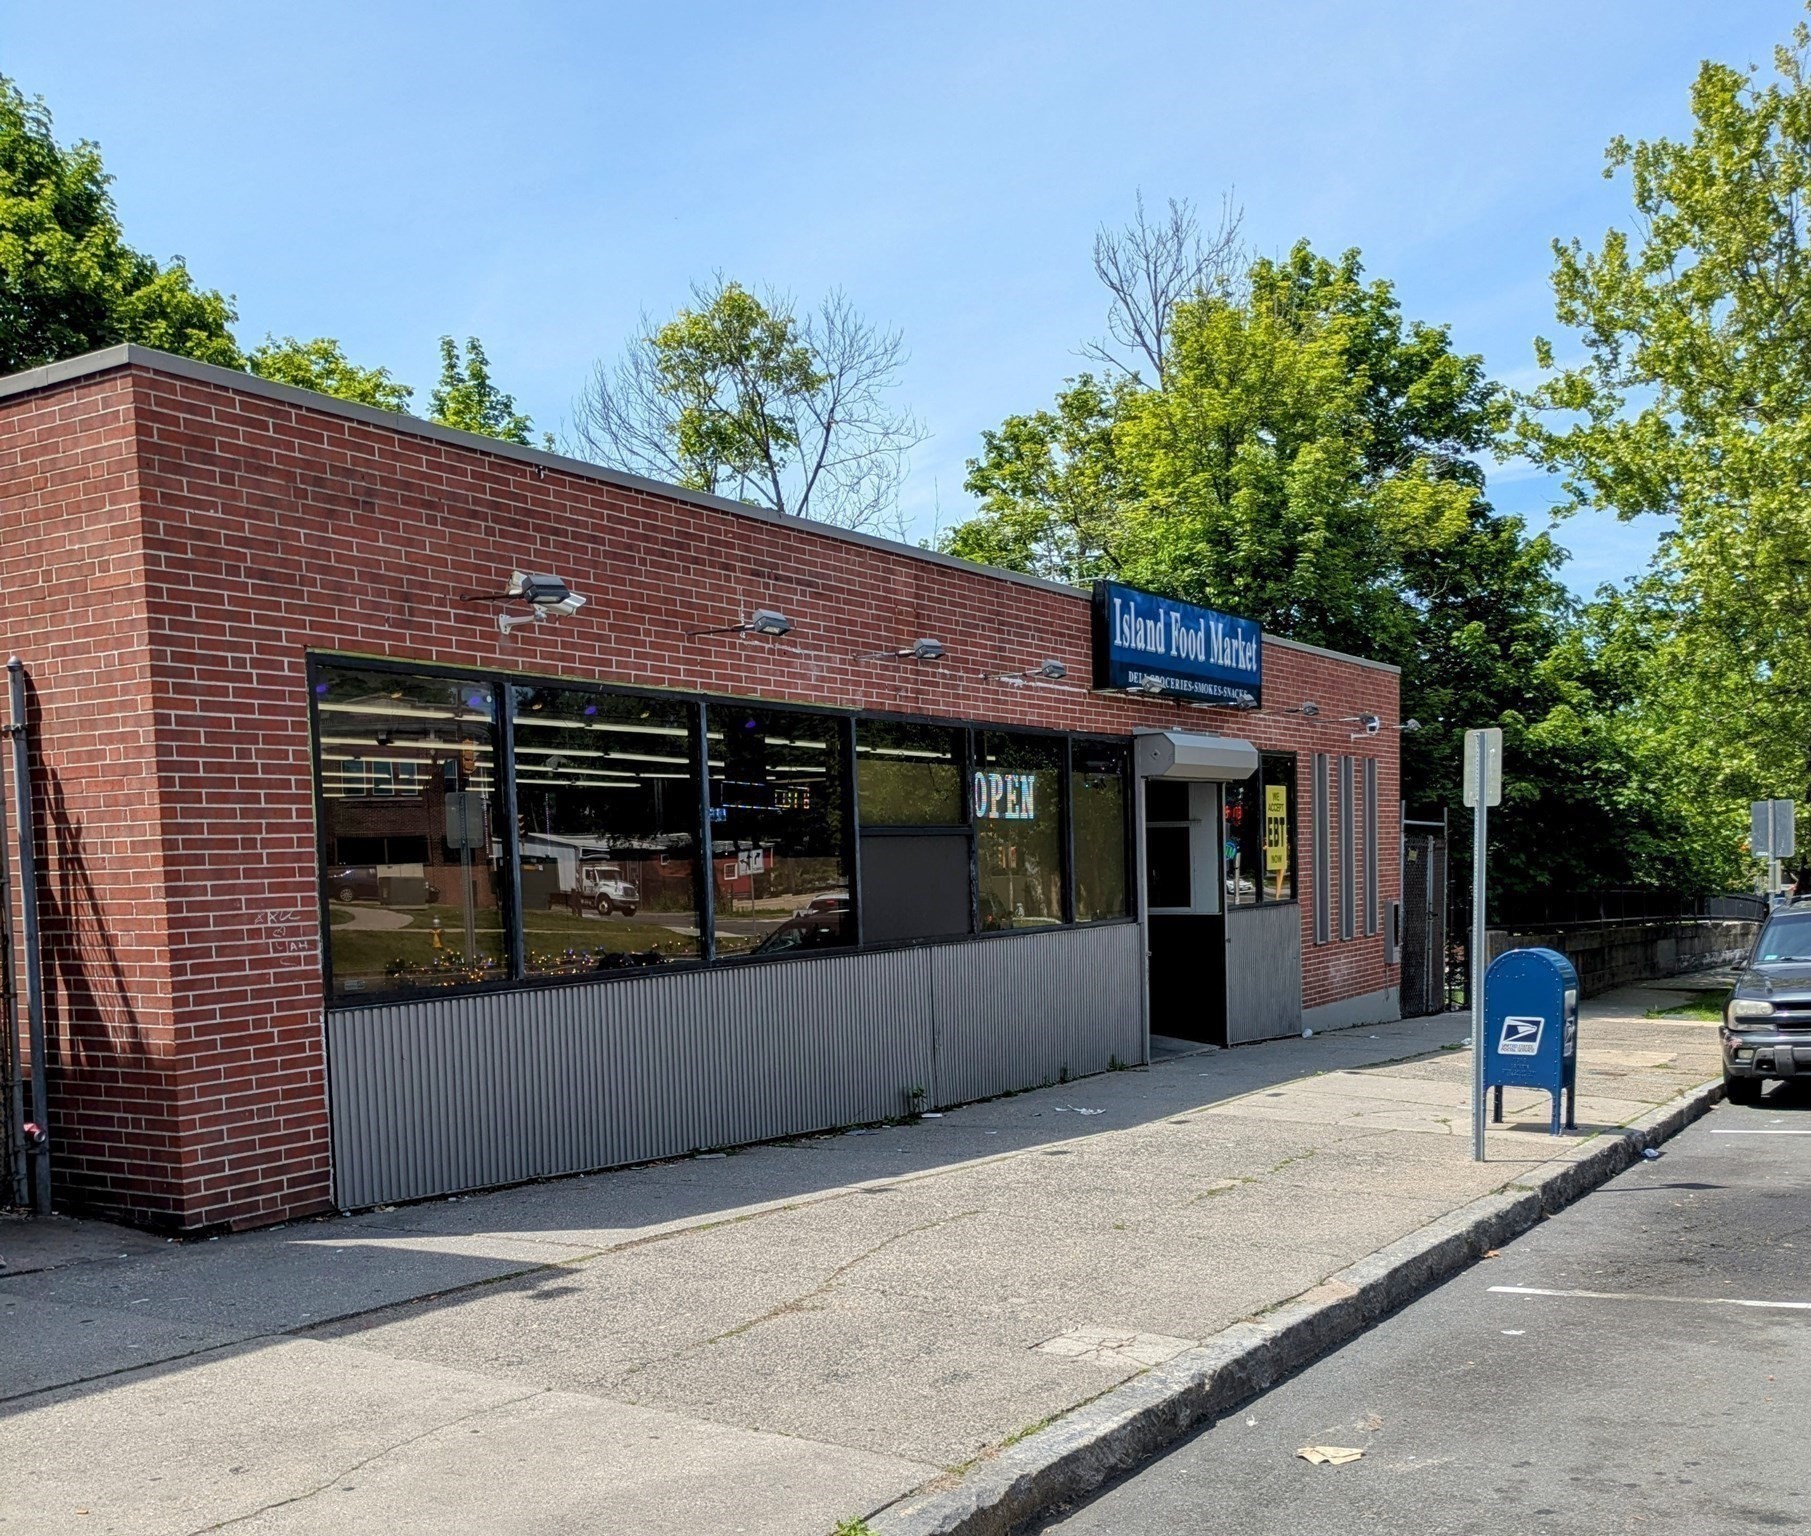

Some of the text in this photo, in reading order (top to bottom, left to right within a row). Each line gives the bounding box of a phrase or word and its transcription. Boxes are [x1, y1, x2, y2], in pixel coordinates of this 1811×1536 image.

[1113, 597, 1258, 673] Island Food Market
[974, 771, 1035, 819] OPEN
[1272, 792, 1280, 801] WE
[1268, 803, 1284, 812] ACCEPT
[1267, 816, 1285, 848] EBT
[1271, 854, 1283, 864] NOW
